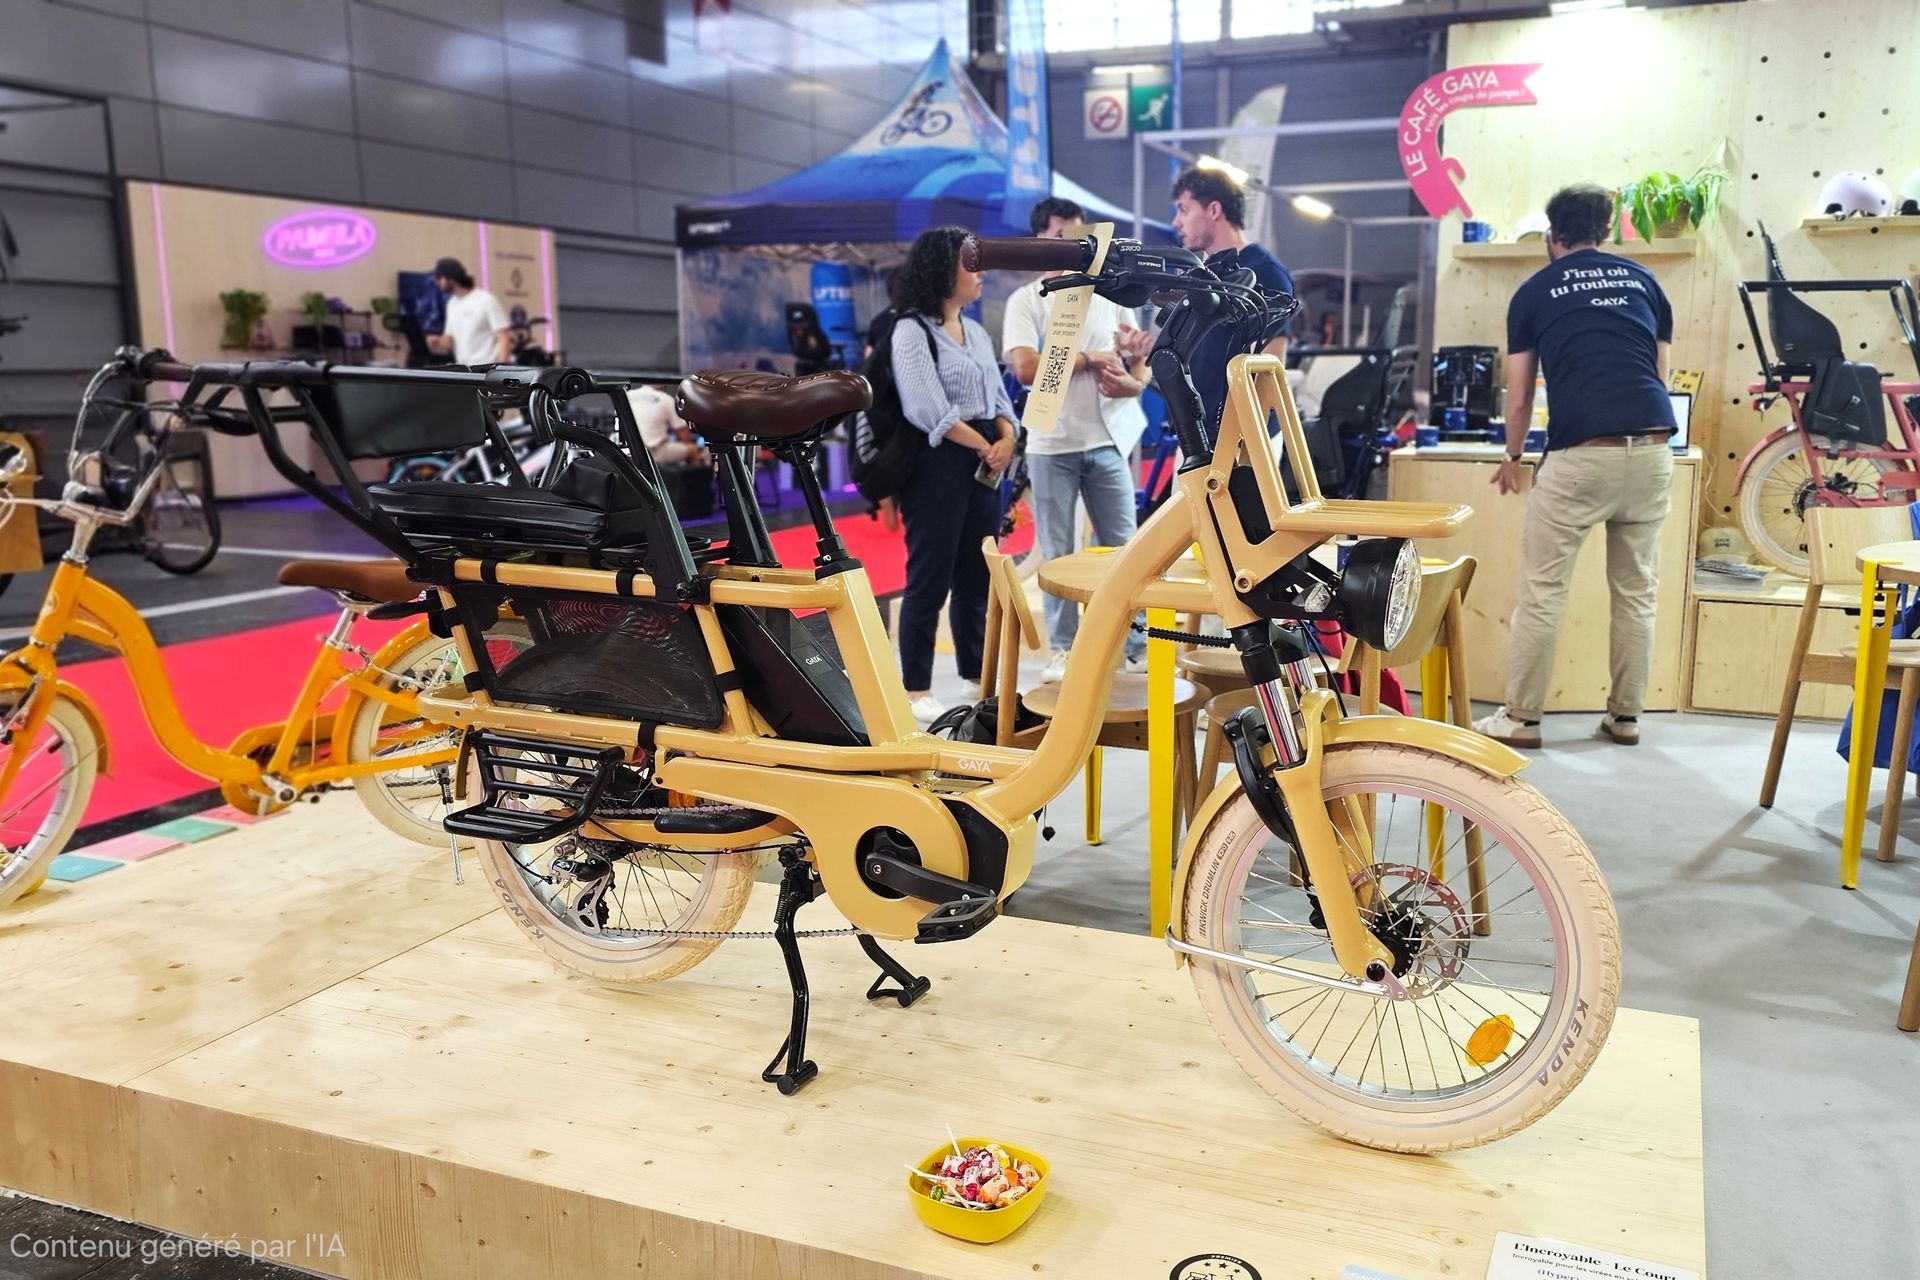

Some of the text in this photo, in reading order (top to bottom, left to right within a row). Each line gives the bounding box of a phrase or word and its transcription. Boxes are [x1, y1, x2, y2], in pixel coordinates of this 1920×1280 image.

[1403, 70, 1499, 177] LE CAFÉ GAYA
[1607, 266, 1630, 277] où
[1550, 285, 1570, 298] tu
[1590, 296, 1629, 306] GAYA
[957, 758, 993, 774] GAYA
[1203, 858, 1220, 900] DRUMLIN
[495, 878, 545, 939] KENDA
[1536, 996, 1589, 1087] KENDA
[1512, 1253, 1554, 1265] Incroyable
[1514, 1243, 1602, 1266] L'Incroyable
[1614, 1262, 1632, 1273] Le
